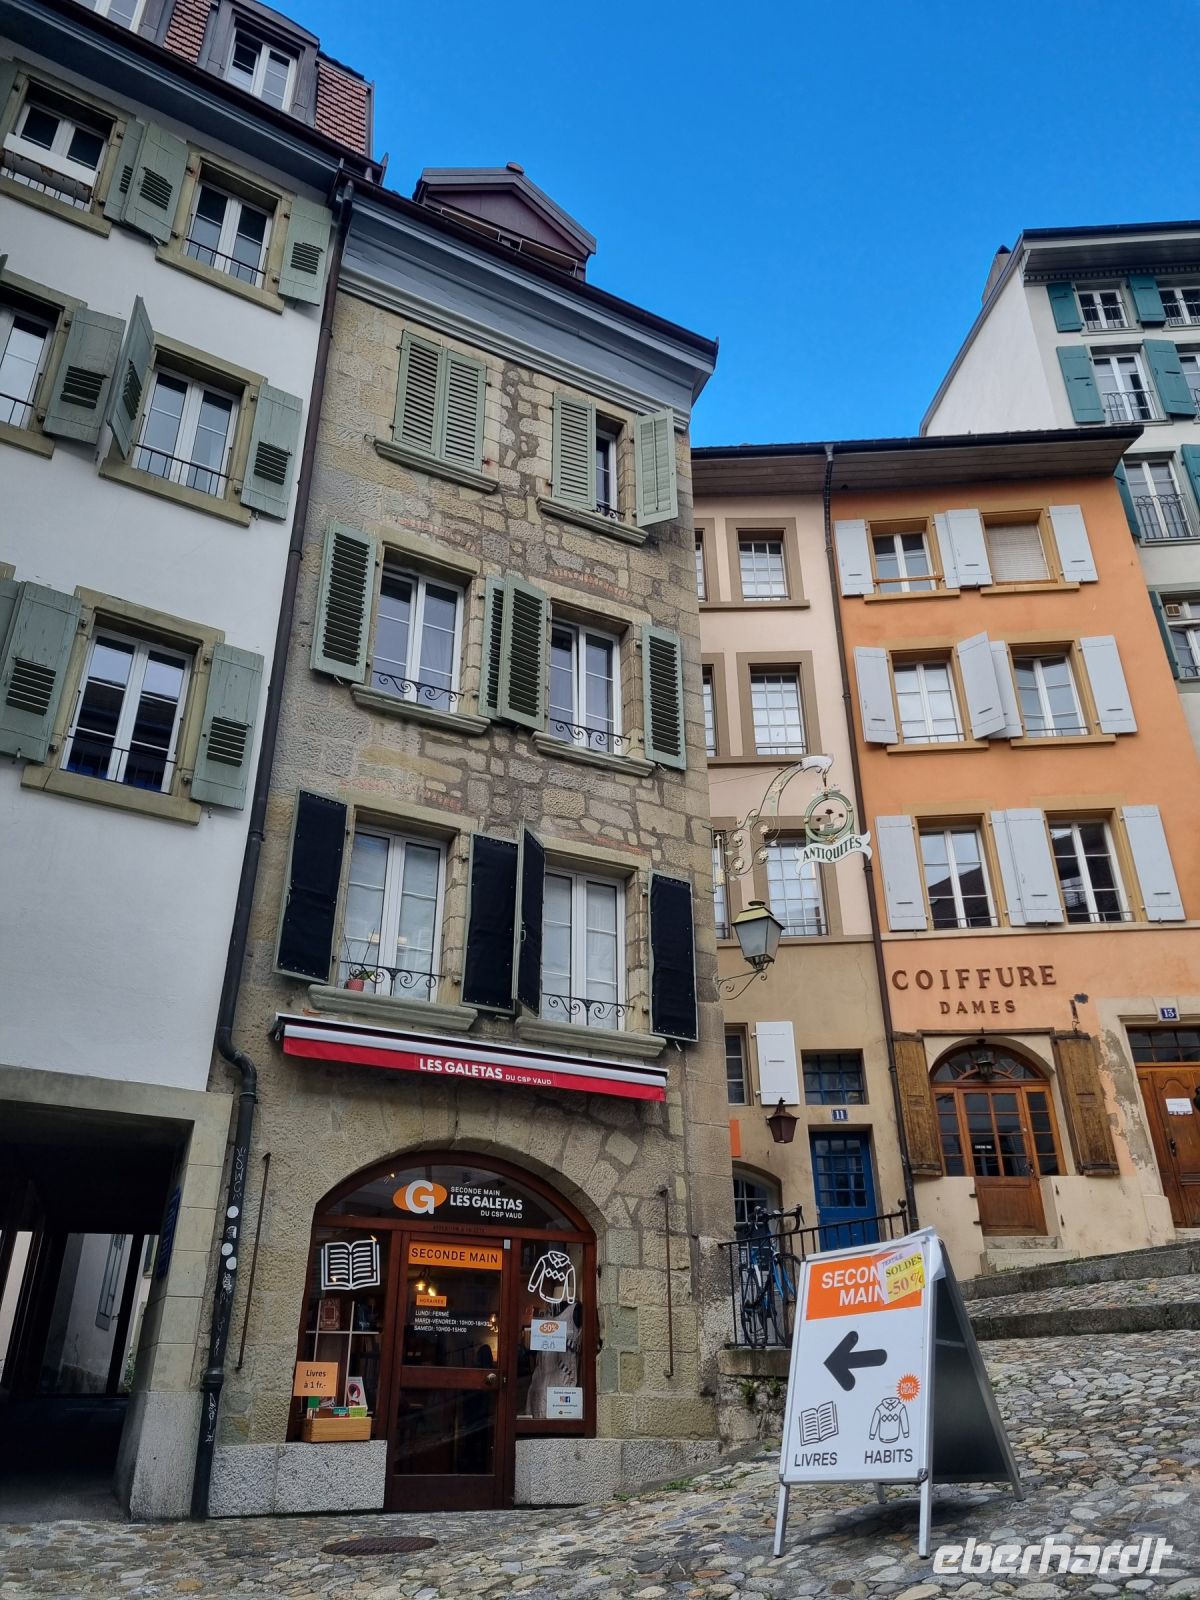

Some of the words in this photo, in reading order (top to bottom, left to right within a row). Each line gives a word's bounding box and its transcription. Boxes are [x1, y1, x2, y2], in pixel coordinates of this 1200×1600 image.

[803, 836, 862, 861] ANTIQUITÉS
[892, 965, 1056, 990] COIFFURE
[939, 1000, 1016, 1014] DAMES
[1164, 1008, 1175, 1018] 13
[419, 1058, 443, 1071] LES
[445, 1062, 503, 1079] GALETAS
[505, 1073, 516, 1081] DU
[517, 1075, 532, 1083] CSP
[533, 1077, 552, 1085] VAUD
[834, 1110, 845, 1120] 11
[405, 1180, 435, 1215] G
[450, 1186, 482, 1195] SECONDE
[483, 1189, 501, 1197] MAIN
[450, 1194, 471, 1207] LES
[472, 1197, 523, 1211] GALETAS
[491, 1211, 504, 1219] CSP
[505, 1212, 523, 1220] VAUD
[410, 1247, 466, 1261] SECONDE
[469, 1252, 499, 1264] MAIN
[885, 1254, 923, 1278] SOLDES
[306, 1369, 327, 1377] Livres
[794, 1452, 838, 1467] LIVRES
[864, 1448, 913, 1464] HABITS
